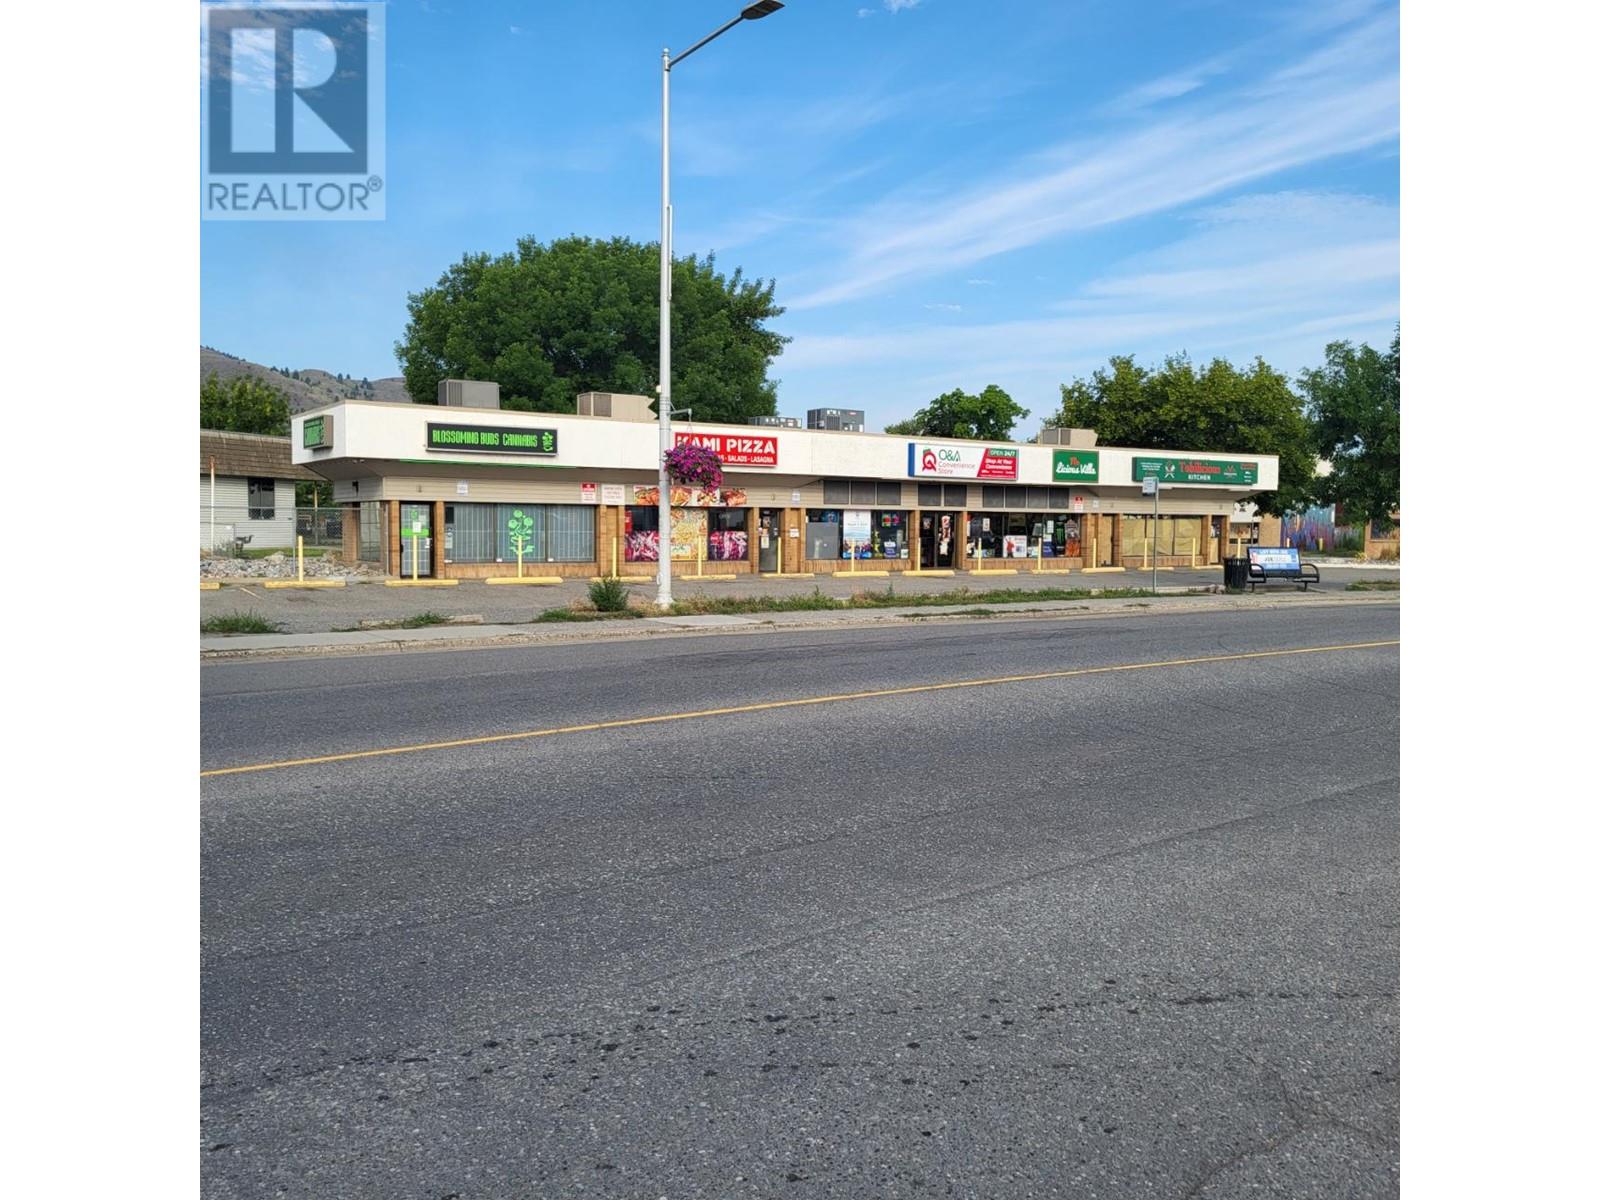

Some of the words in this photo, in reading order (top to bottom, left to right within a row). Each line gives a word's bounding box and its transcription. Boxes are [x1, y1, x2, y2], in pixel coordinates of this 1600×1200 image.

[432, 429, 479, 445] BLOSSOMING
[480, 431, 500, 446] BUDS
[502, 433, 538, 447] CANNABIS
[726, 438, 776, 454] PIZZA
[1188, 473, 1211, 481] KITCHEN
